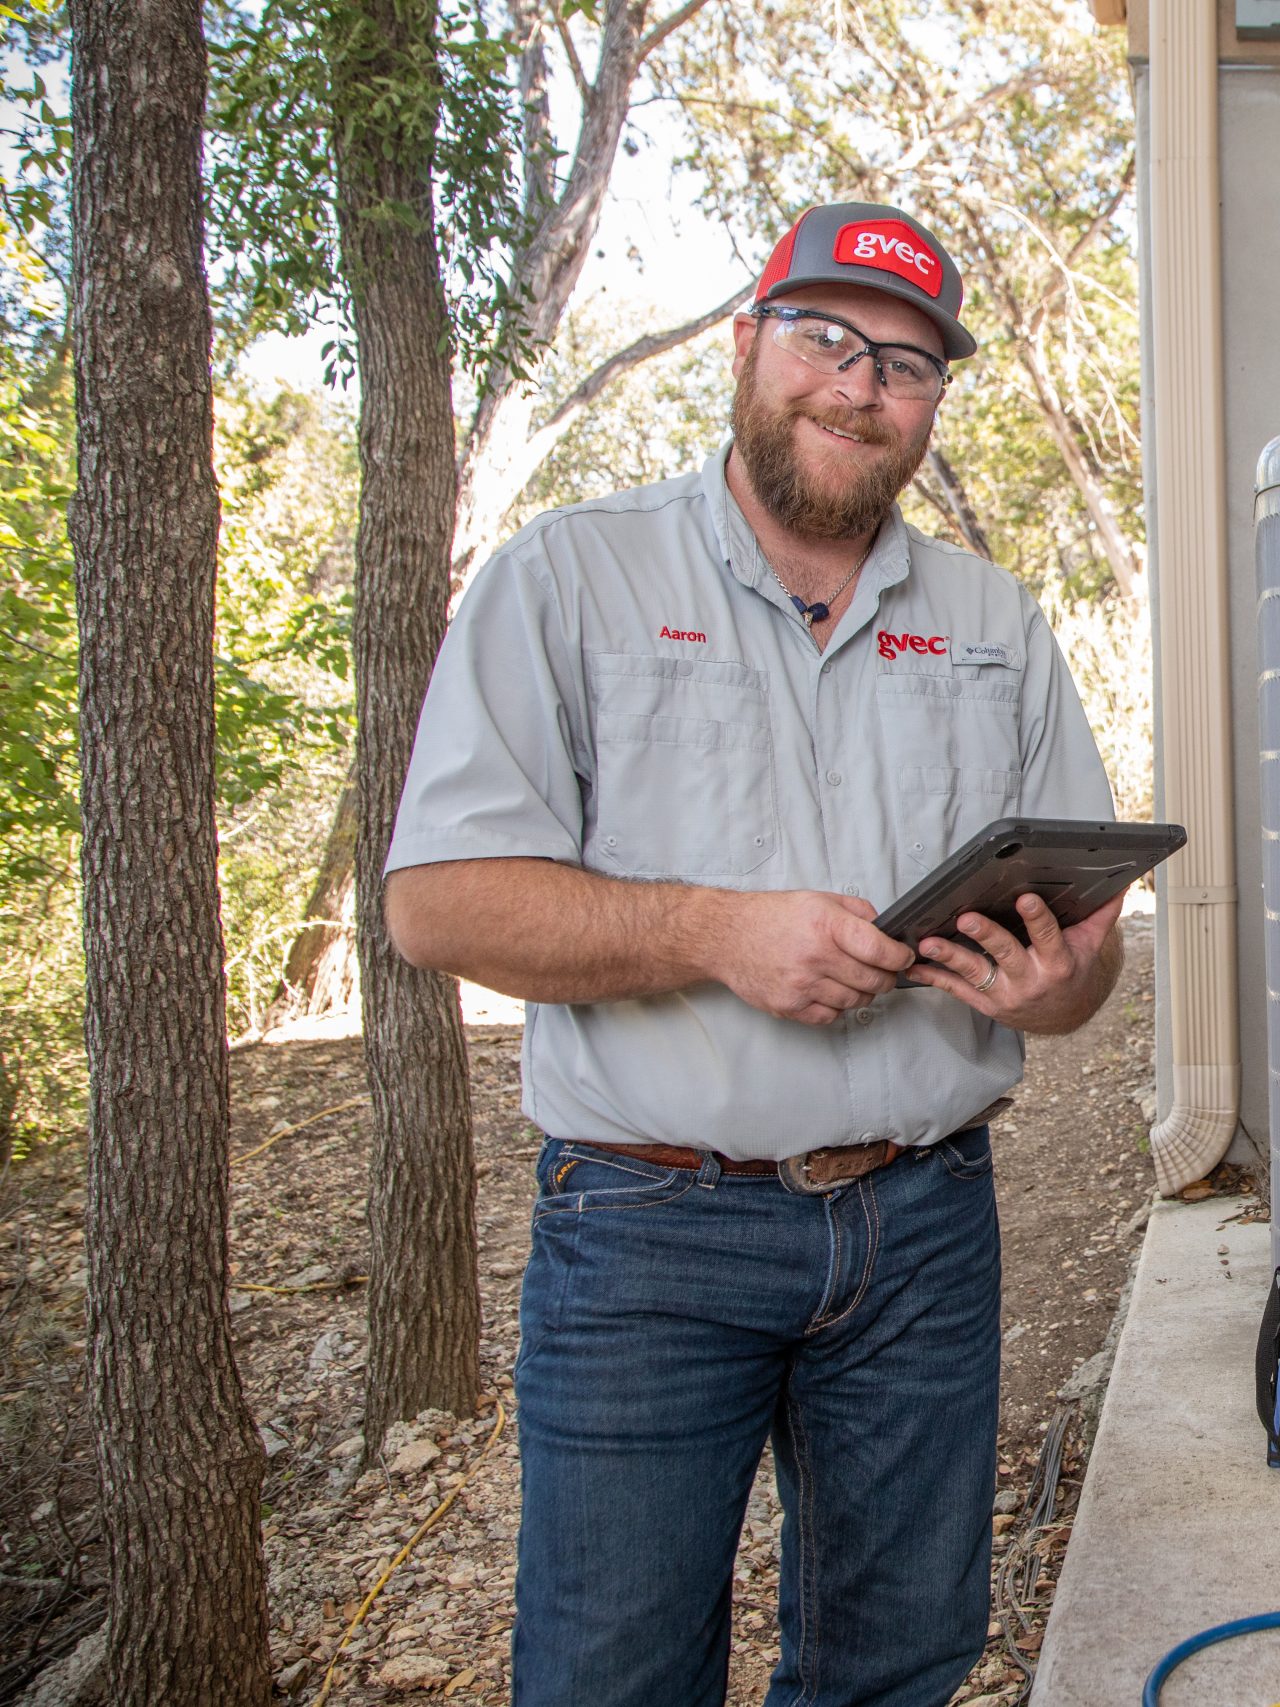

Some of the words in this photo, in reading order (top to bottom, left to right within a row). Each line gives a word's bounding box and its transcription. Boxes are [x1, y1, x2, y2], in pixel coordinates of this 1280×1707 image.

[853, 232, 931, 275] gvec
[659, 625, 706, 643] Aaron
[877, 630, 947, 661] gvec
